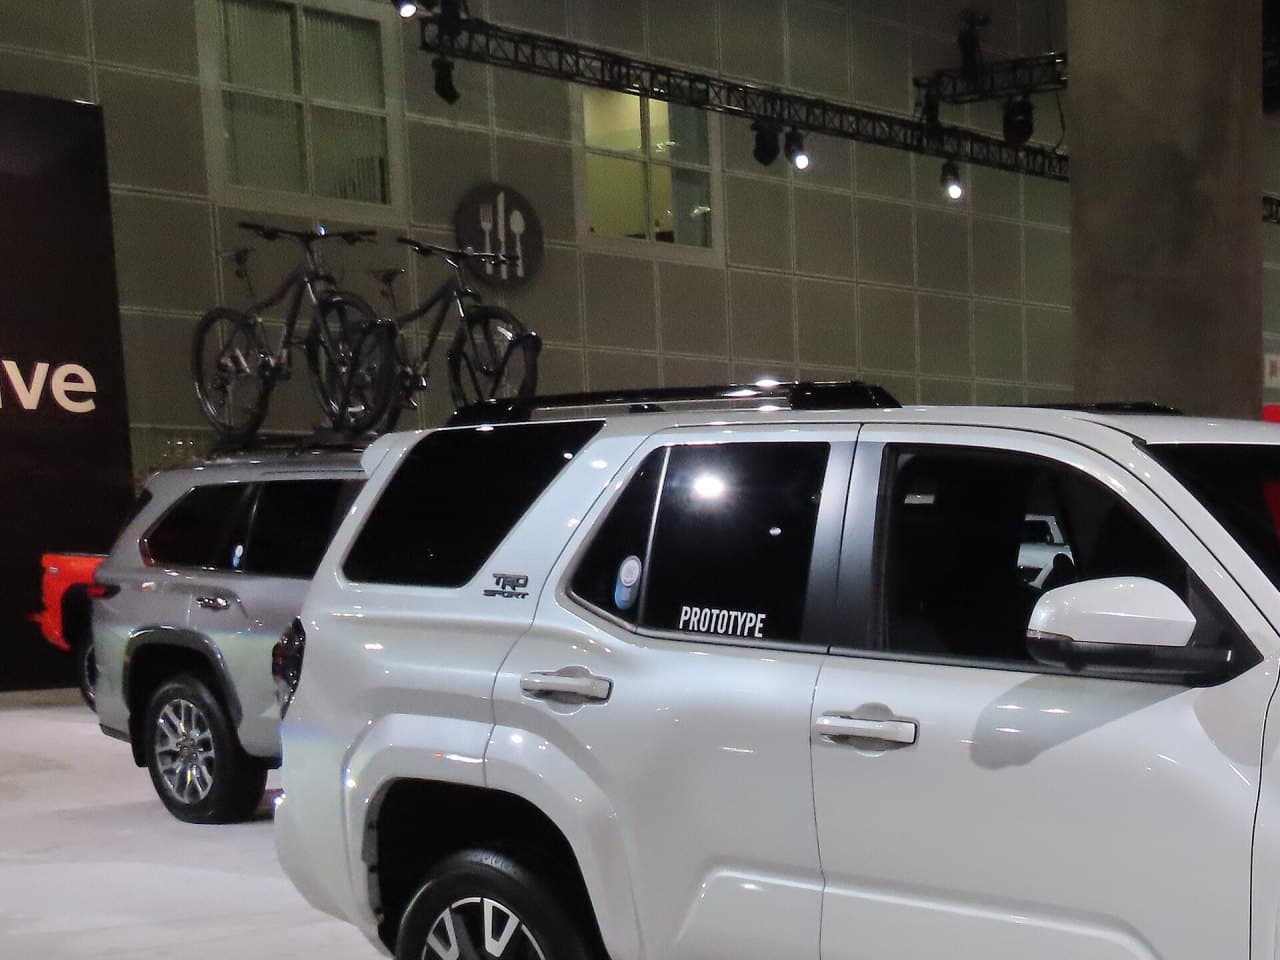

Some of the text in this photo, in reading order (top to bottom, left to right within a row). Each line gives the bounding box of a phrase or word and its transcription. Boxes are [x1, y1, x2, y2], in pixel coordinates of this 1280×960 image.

[0, 359, 97, 413] ve
[492, 573, 529, 591] TRD
[679, 605, 767, 638] PROTOTYPE
